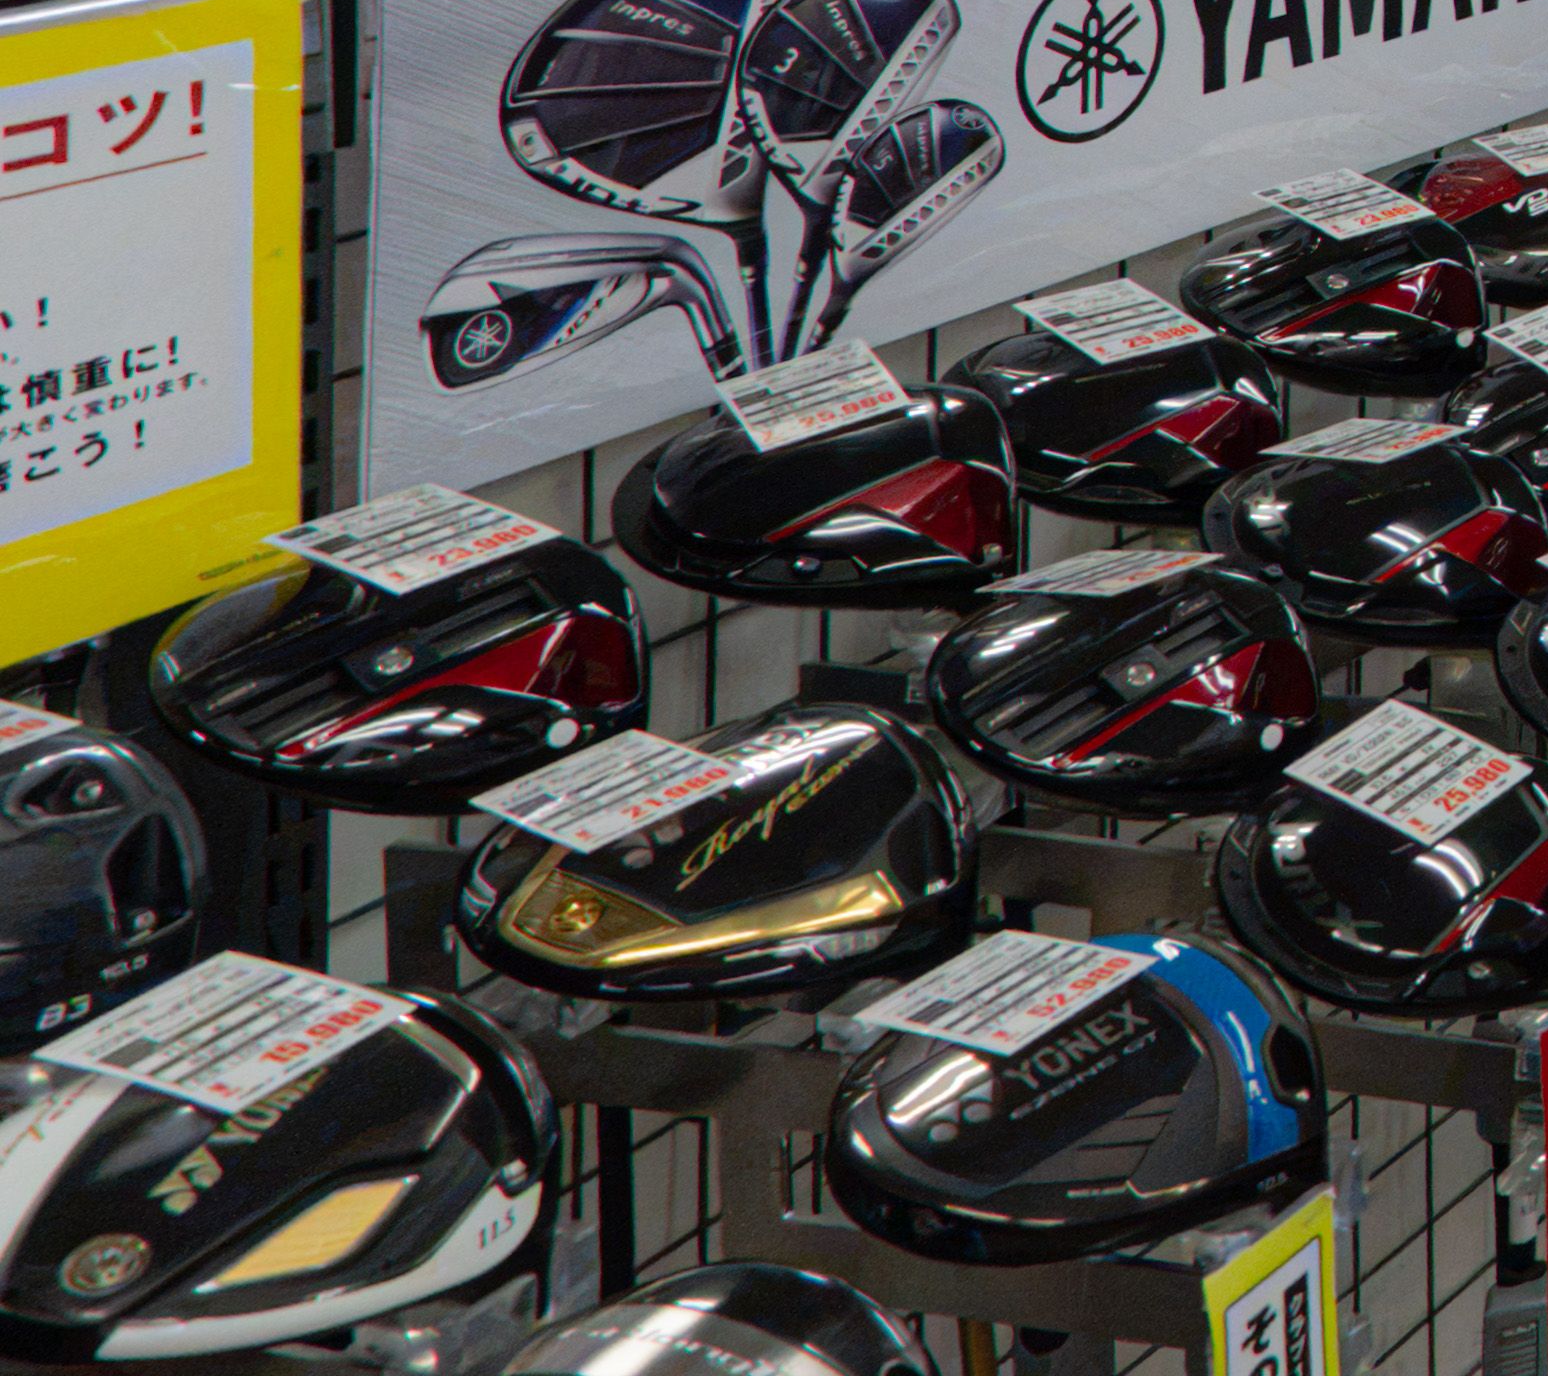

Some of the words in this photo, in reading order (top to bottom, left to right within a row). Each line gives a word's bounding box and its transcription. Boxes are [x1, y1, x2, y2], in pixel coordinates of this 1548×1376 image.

[771, 47, 800, 75] 3
[1, 80, 206, 174] コツ!
[0, 336, 180, 414] 慎重に!
[0, 418, 146, 494] こう!
[1434, 757, 1512, 816] 25,980
[1005, 1000, 1150, 1091] YONEX
